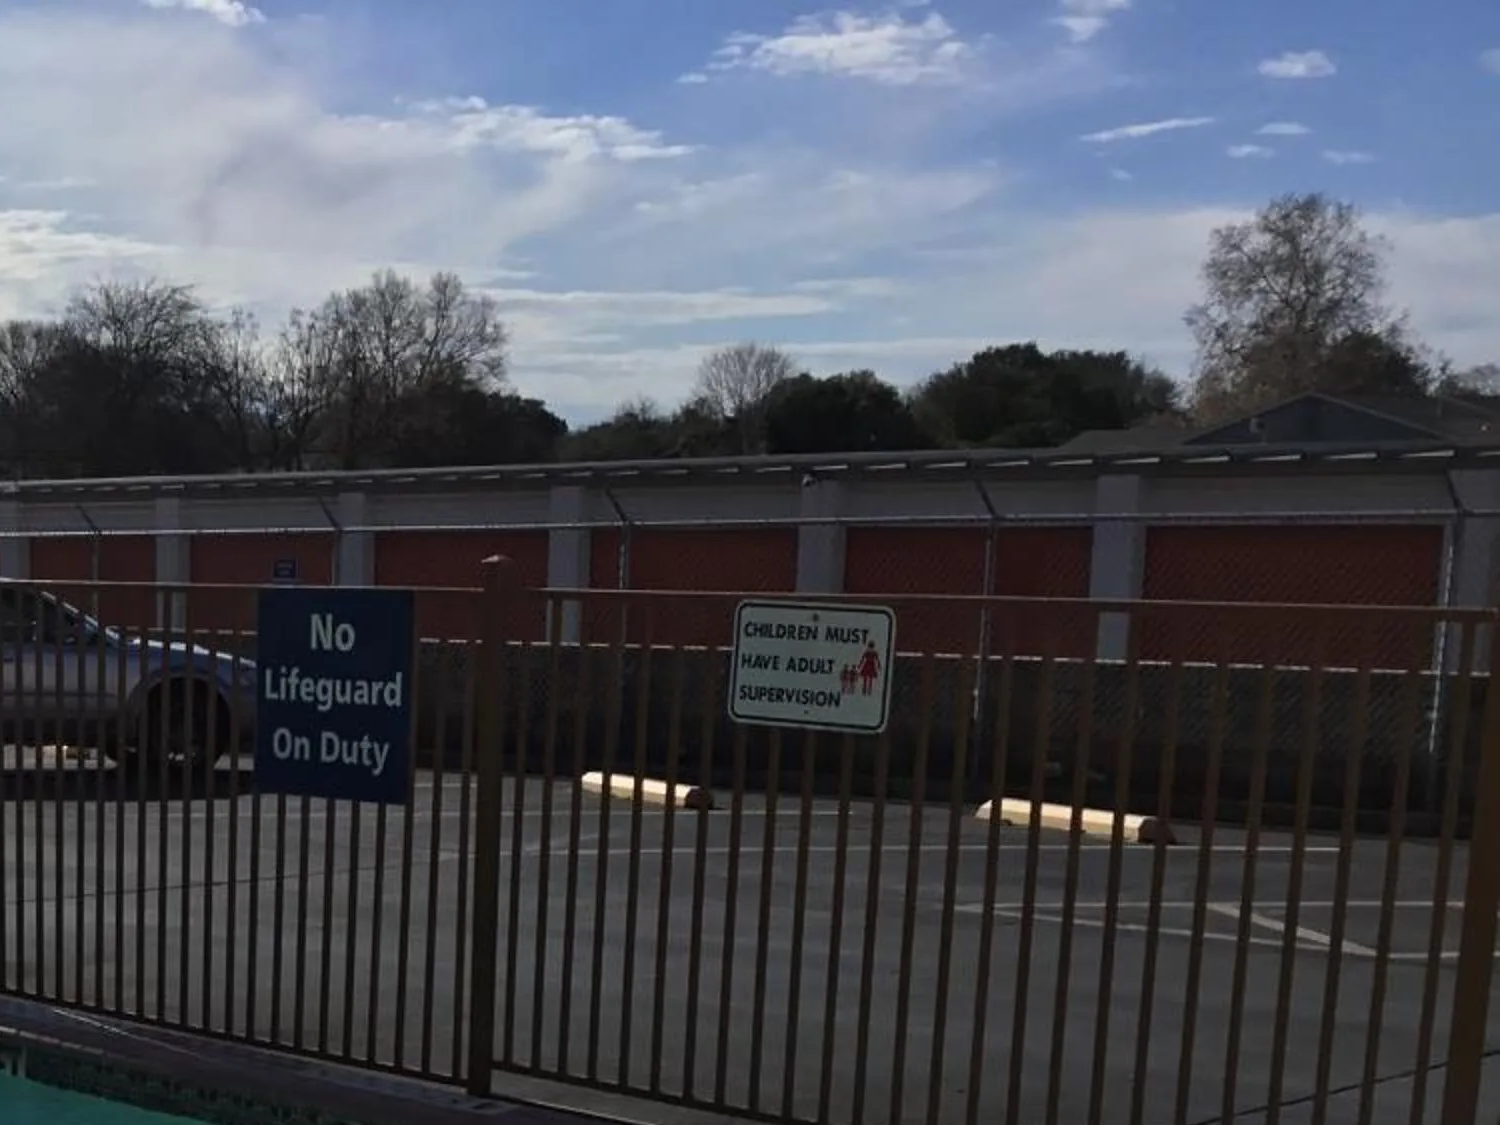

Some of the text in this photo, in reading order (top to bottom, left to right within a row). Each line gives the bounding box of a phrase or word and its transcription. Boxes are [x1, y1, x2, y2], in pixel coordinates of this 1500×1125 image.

[311, 614, 355, 650] No
[744, 621, 869, 644] CHILDREN MUST
[741, 653, 835, 674] HAVE ADULT
[265, 666, 402, 711] Lifeguard
[739, 684, 841, 708] SUPERVISION
[273, 728, 389, 776] On Duty
